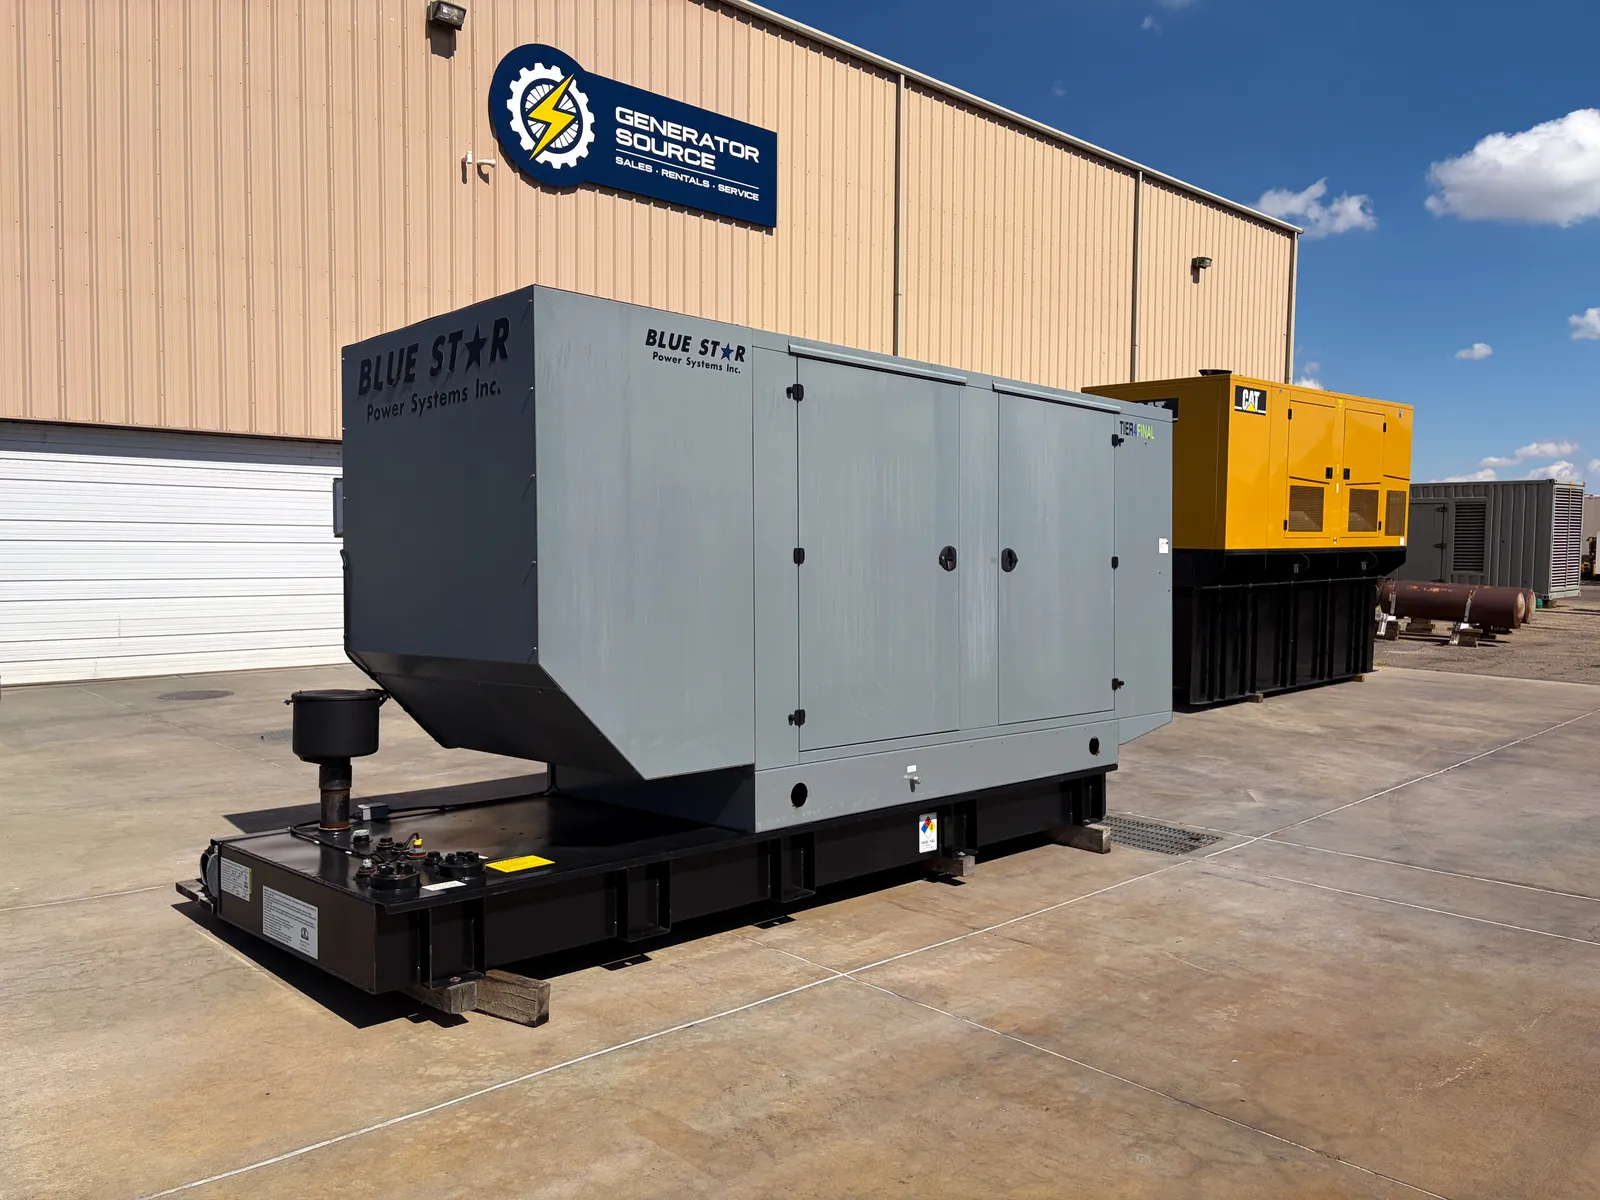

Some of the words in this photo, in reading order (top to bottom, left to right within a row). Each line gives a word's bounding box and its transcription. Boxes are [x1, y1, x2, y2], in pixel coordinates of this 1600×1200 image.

[615, 106, 760, 163] GENERATOR
[615, 128, 716, 170] SOURCE
[615, 156, 653, 173] SALES
[661, 168, 710, 188] RENTALS
[718, 183, 760, 201] SERVICE
[645, 328, 692, 353] BLUE
[358, 343, 419, 396] BLUE
[652, 351, 682, 364] Power
[686, 357, 723, 372] Systems
[726, 364, 741, 374] Inc.
[367, 402, 405, 423] Power
[411, 387, 469, 418] Systems
[475, 378, 501, 399] Inc.
[1242, 389, 1260, 412] CAT
